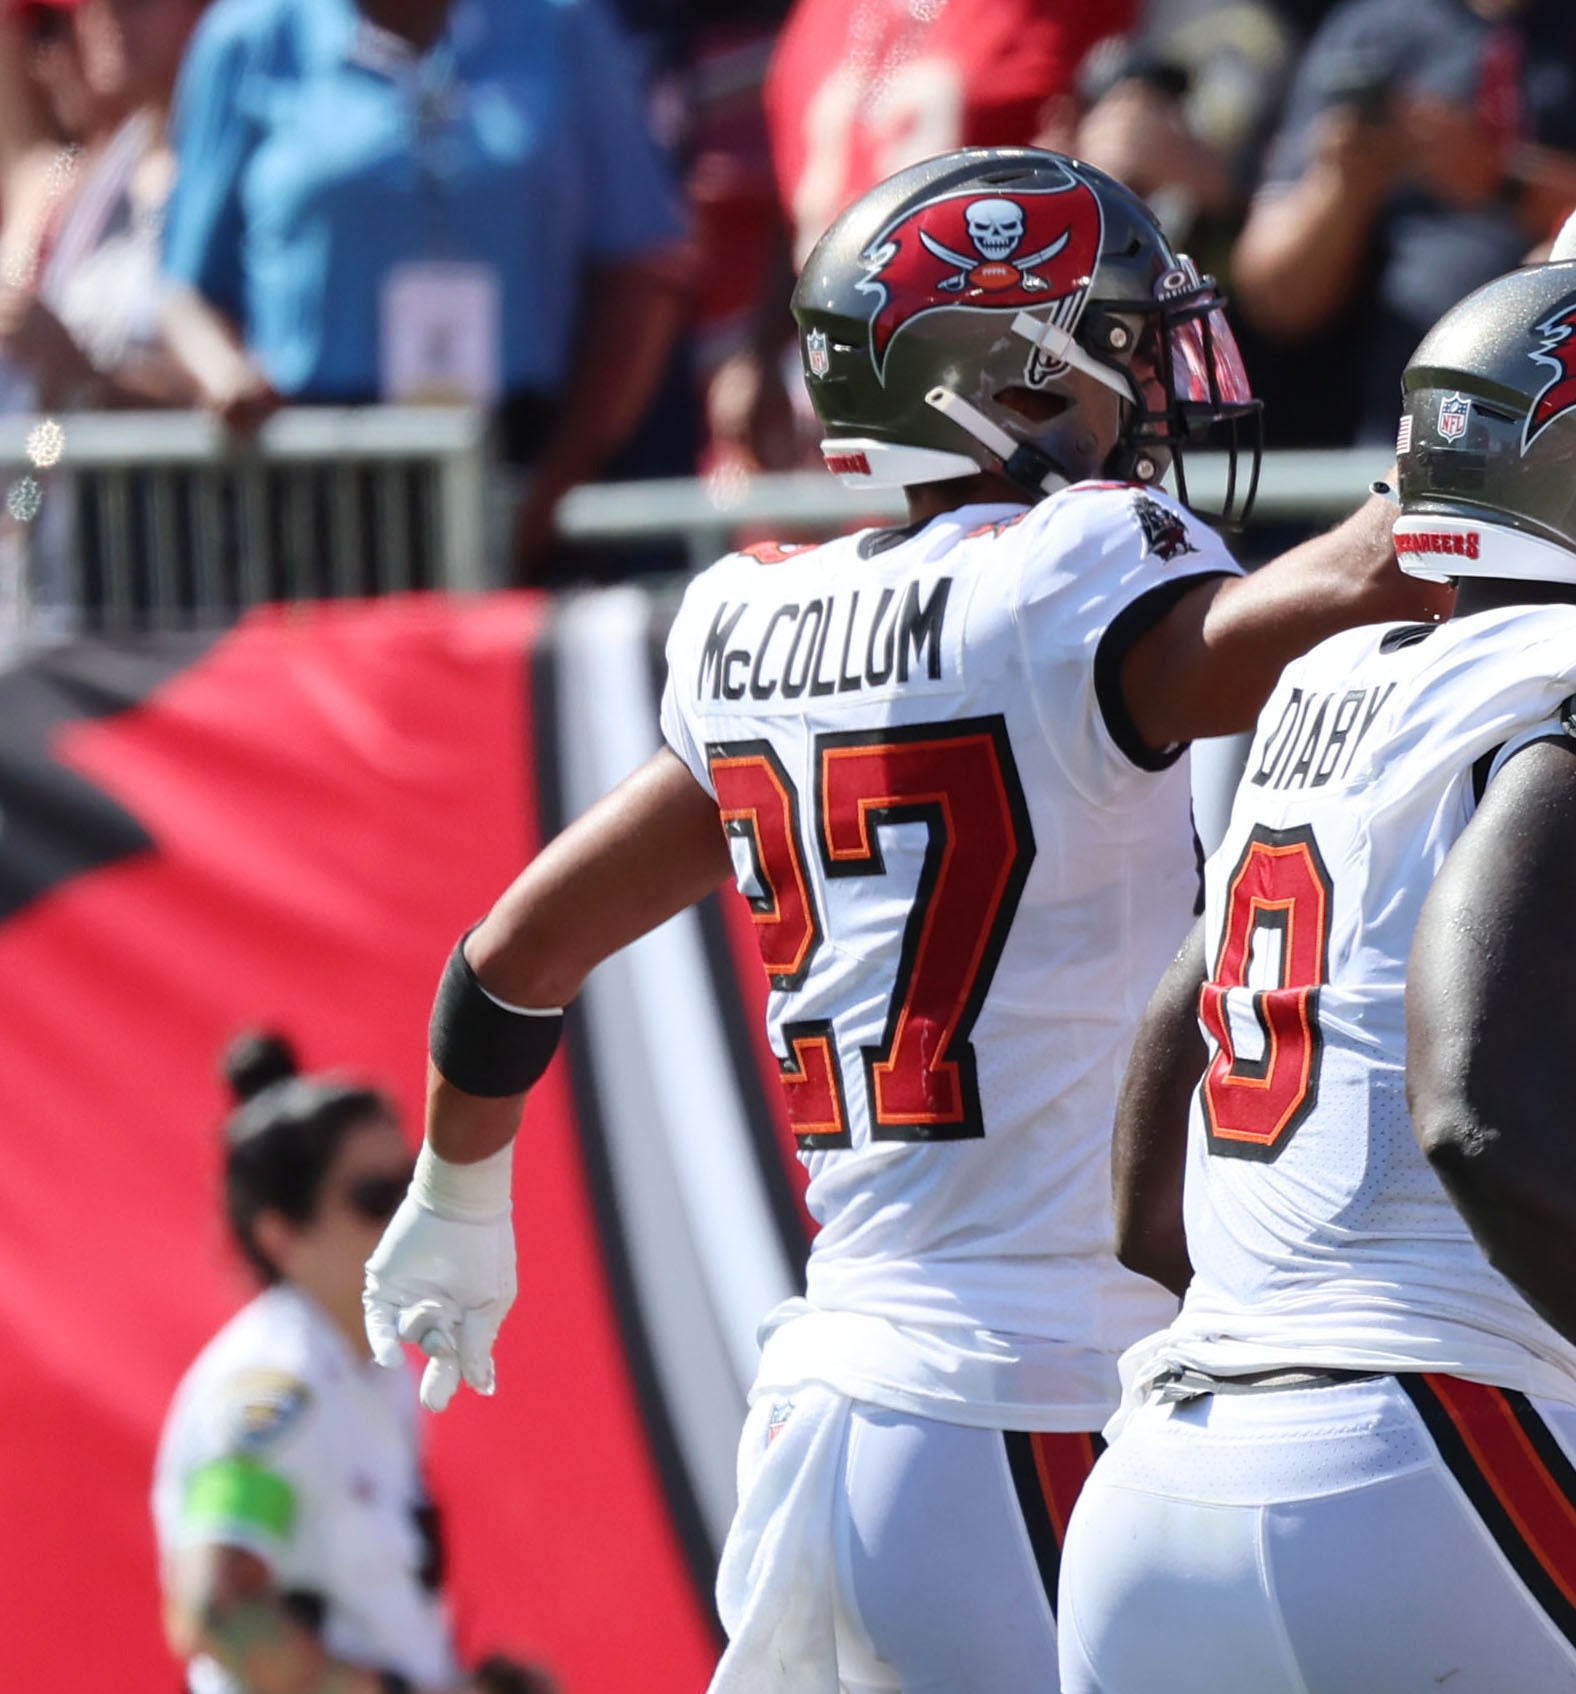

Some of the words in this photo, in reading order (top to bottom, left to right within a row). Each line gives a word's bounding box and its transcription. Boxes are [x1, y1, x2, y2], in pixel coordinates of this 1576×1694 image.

[1441, 414, 1464, 435] NFL
[697, 576, 953, 701] McCOLLUM
[1250, 682, 1397, 790] DIABY
[704, 713, 1037, 1150] 27
[1198, 822, 1333, 1165] 0
